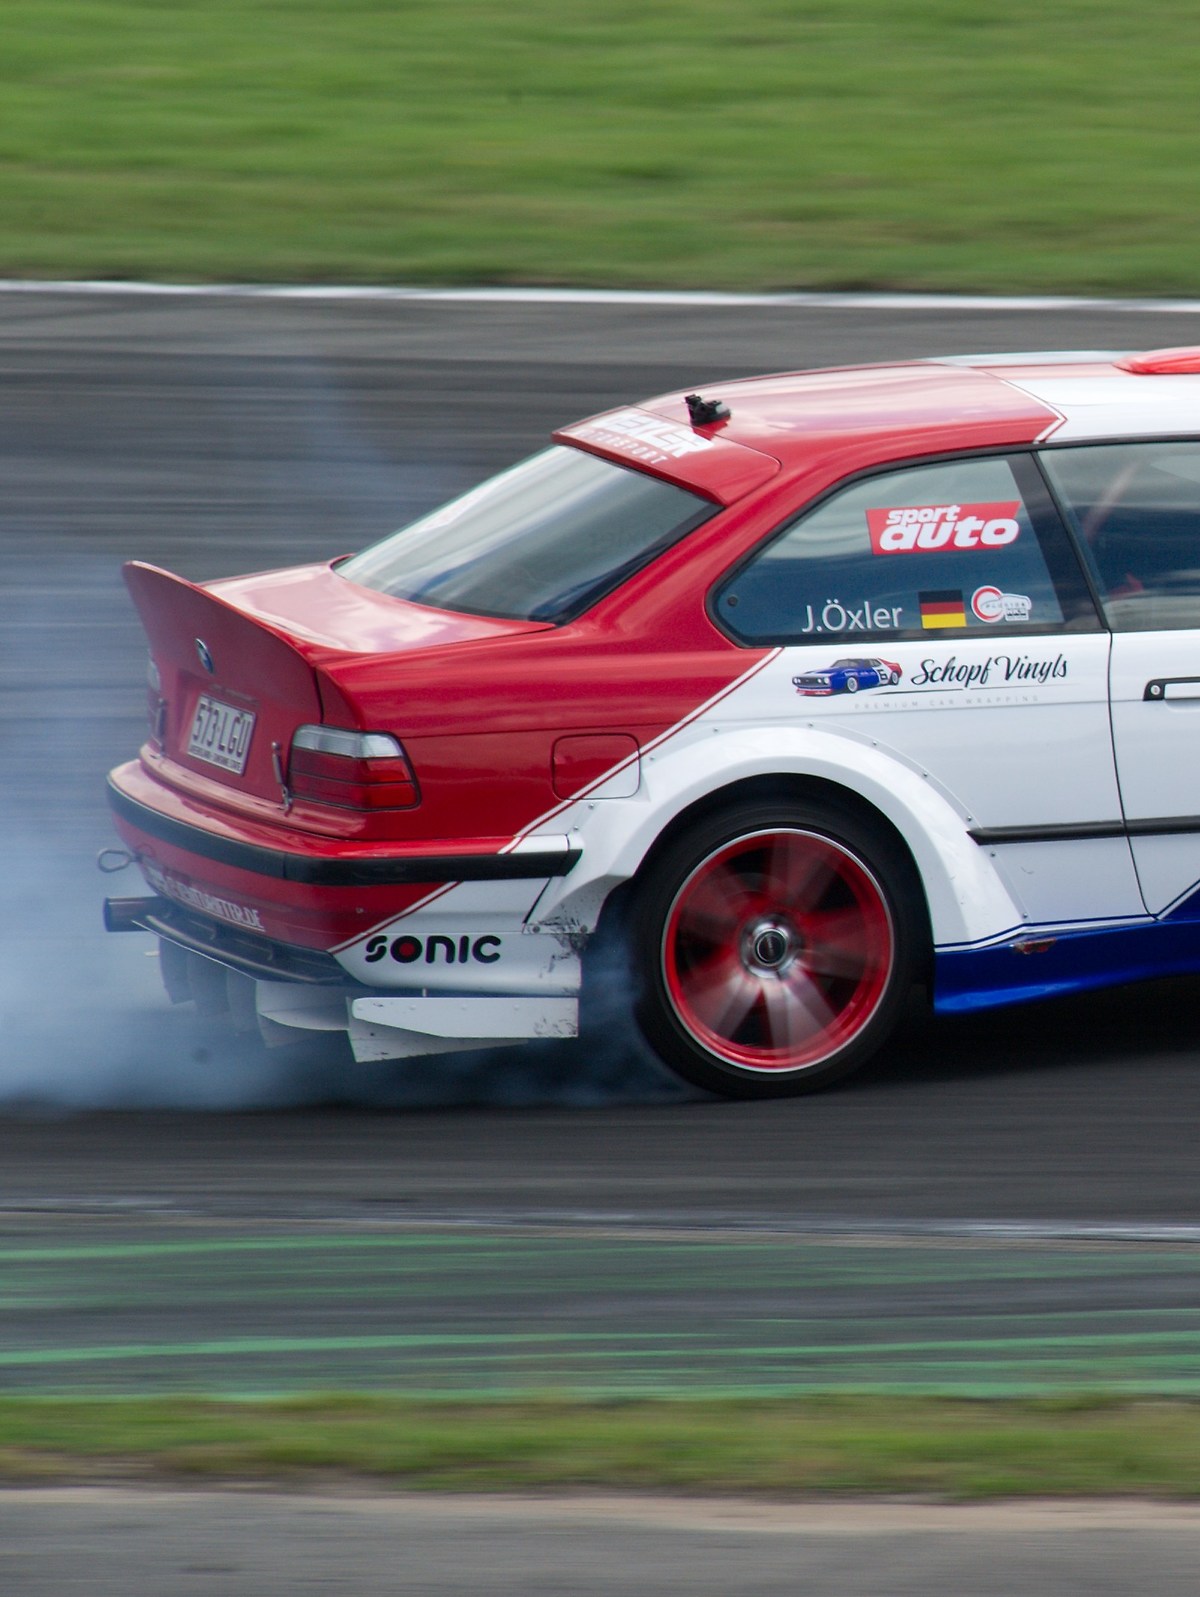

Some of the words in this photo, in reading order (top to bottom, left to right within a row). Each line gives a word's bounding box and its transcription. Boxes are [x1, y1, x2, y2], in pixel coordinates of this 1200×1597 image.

[886, 504, 961, 527] sport
[879, 516, 1020, 551] auto
[802, 598, 903, 632] J.Öxler
[911, 656, 992, 688] Schopf
[994, 653, 1068, 684] Vinyls
[855, 700, 919, 710] PREMIUM
[929, 698, 955, 707] CAR
[966, 695, 1039, 705] WRAPPING
[365, 935, 502, 963] SONIC
